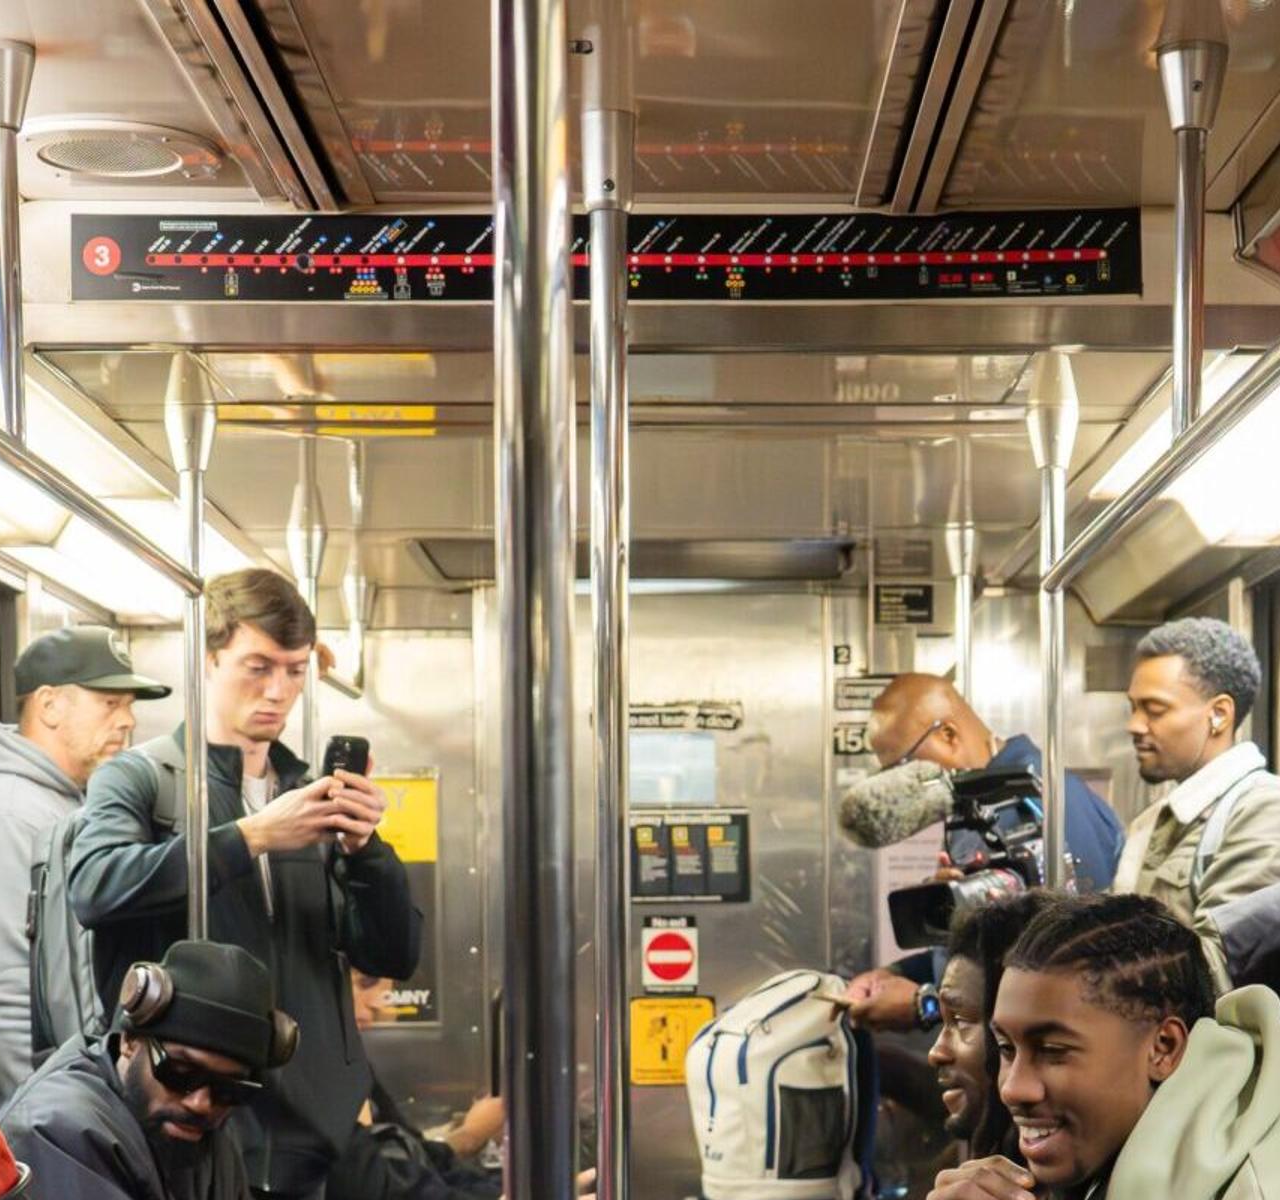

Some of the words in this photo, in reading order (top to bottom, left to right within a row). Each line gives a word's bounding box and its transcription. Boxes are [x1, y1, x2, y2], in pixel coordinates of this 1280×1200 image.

[94, 245, 111, 267] 3
[836, 645, 850, 664] 2
[381, 989, 431, 1007] OMNY
